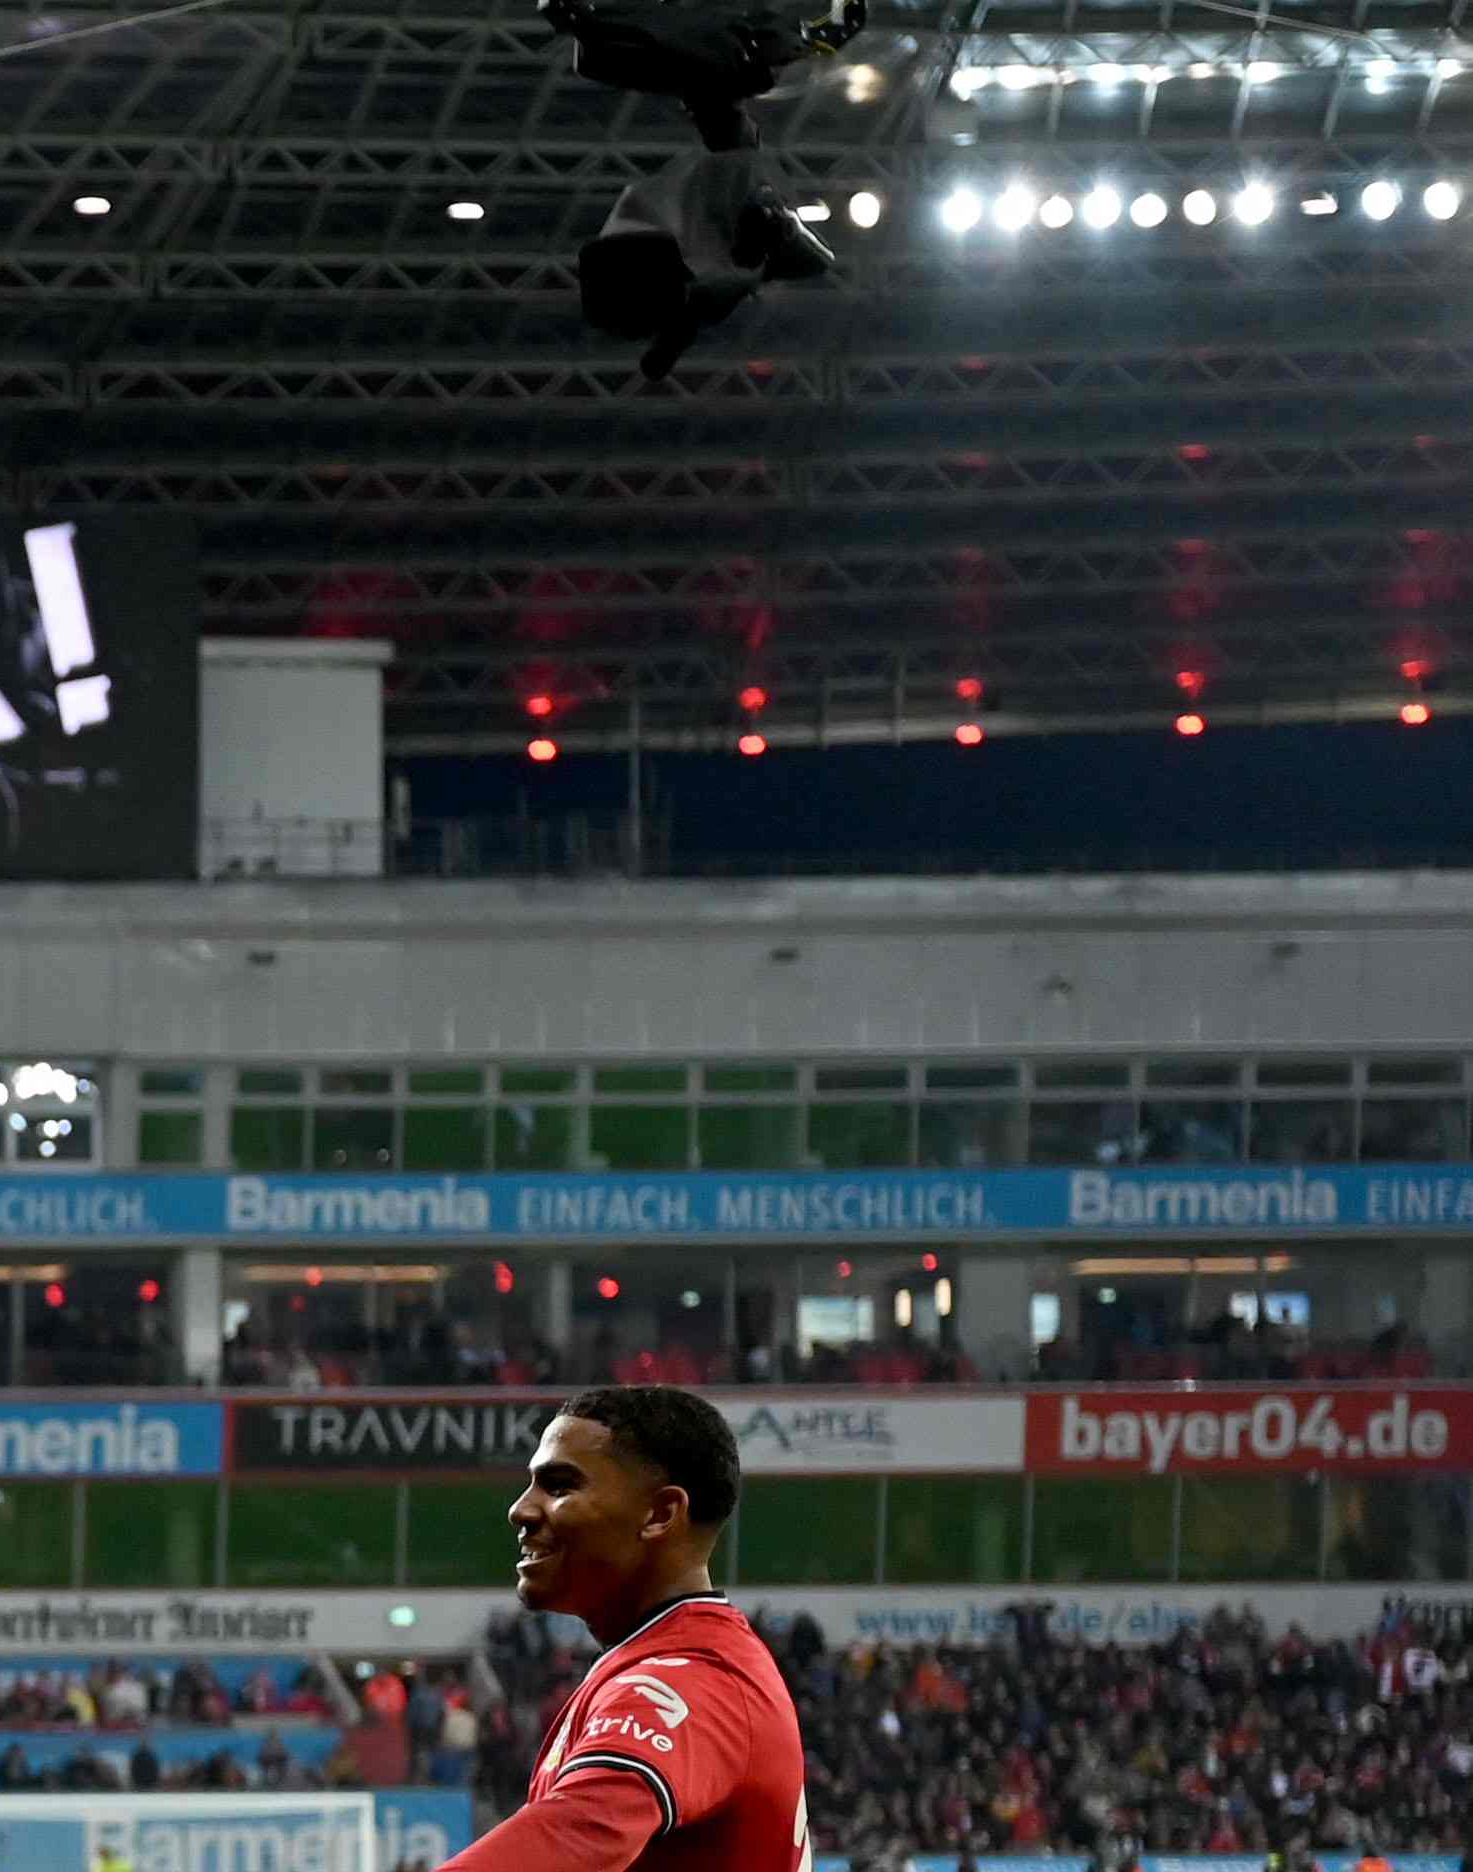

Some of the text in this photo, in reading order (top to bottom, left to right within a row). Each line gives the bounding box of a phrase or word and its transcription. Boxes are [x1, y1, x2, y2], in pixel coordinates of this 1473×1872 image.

[227, 1176, 490, 1231] Barmenia
[519, 1186, 702, 1233] EINFACH.
[717, 1182, 996, 1229] MENSCHLICH.
[1070, 1169, 1337, 1224] Barmenia
[1059, 1396, 1449, 1472] bayer04.de
[586, 1714, 673, 1753] trive
